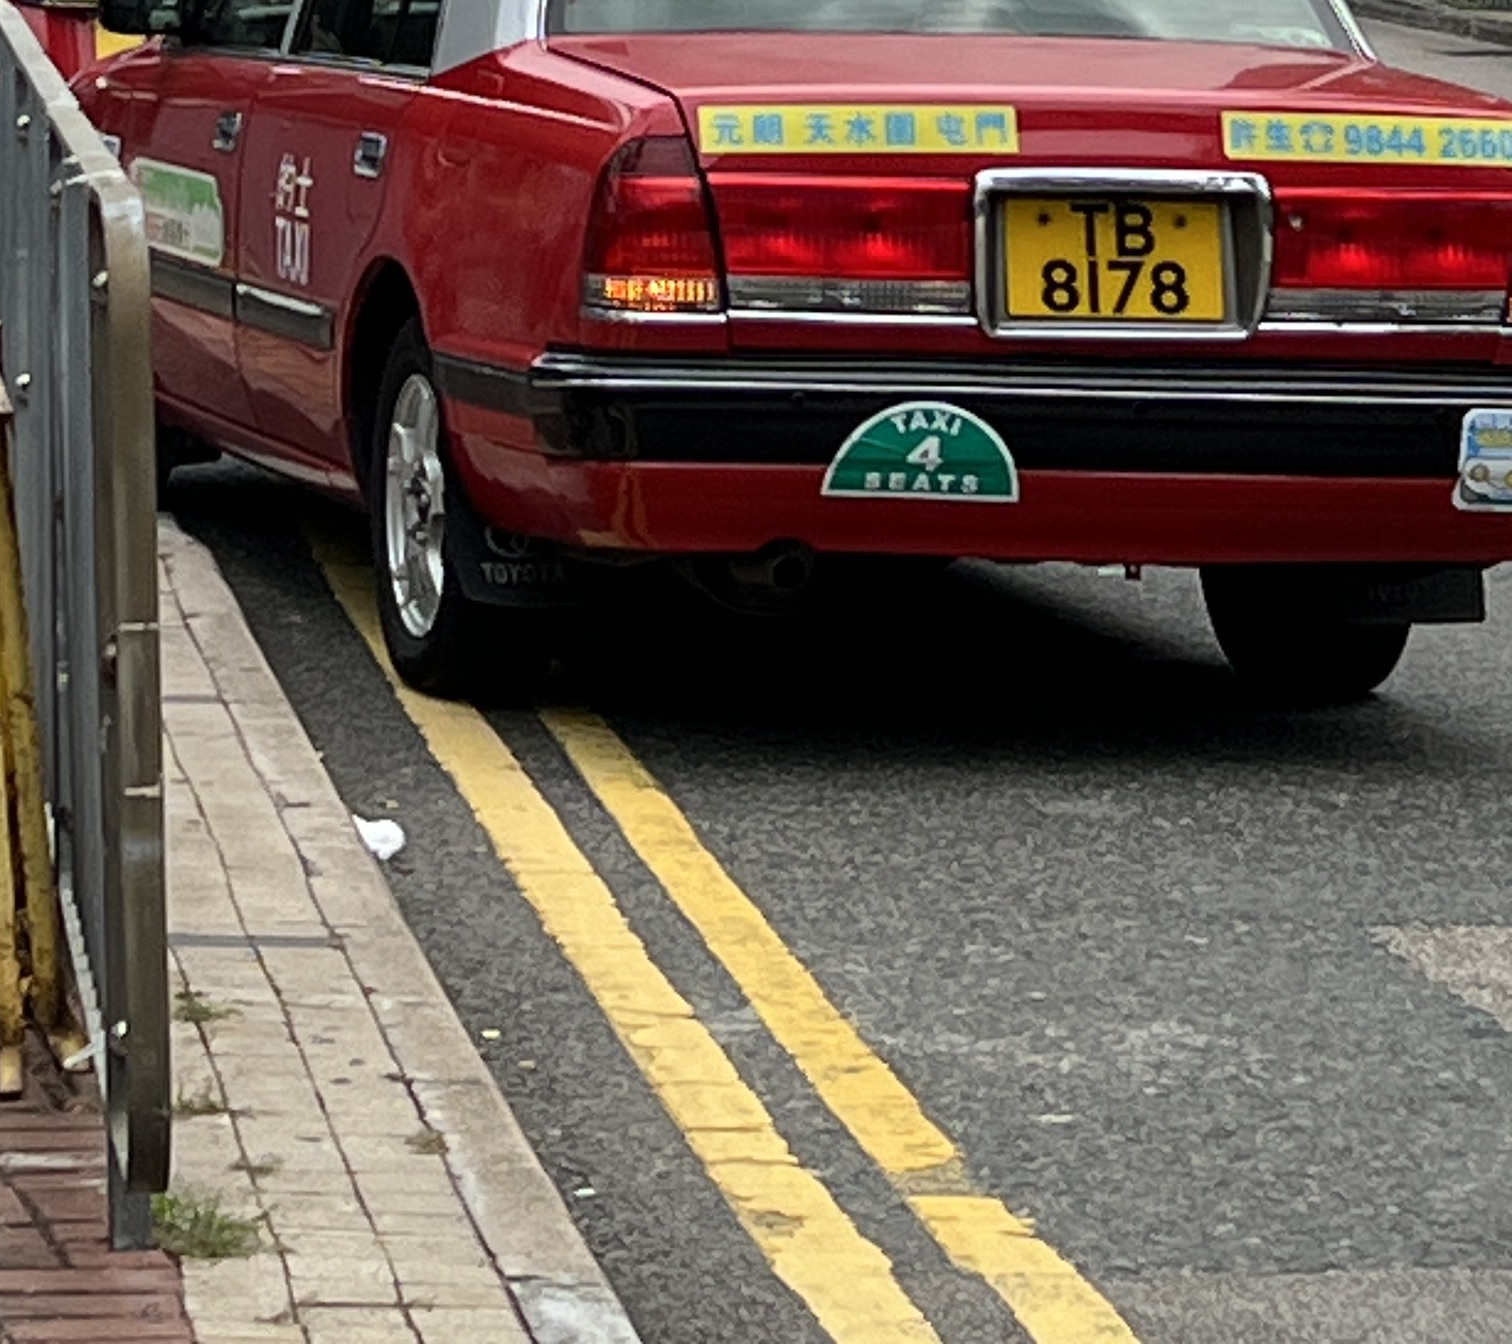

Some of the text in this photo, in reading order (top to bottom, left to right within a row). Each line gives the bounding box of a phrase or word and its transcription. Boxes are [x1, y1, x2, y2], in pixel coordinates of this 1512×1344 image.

[1070, 202, 1155, 257] TB
[1041, 259, 1190, 314] 8178
[890, 410, 962, 436] TAXI
[906, 435, 943, 471] 4
[864, 472, 979, 494] SEATS
